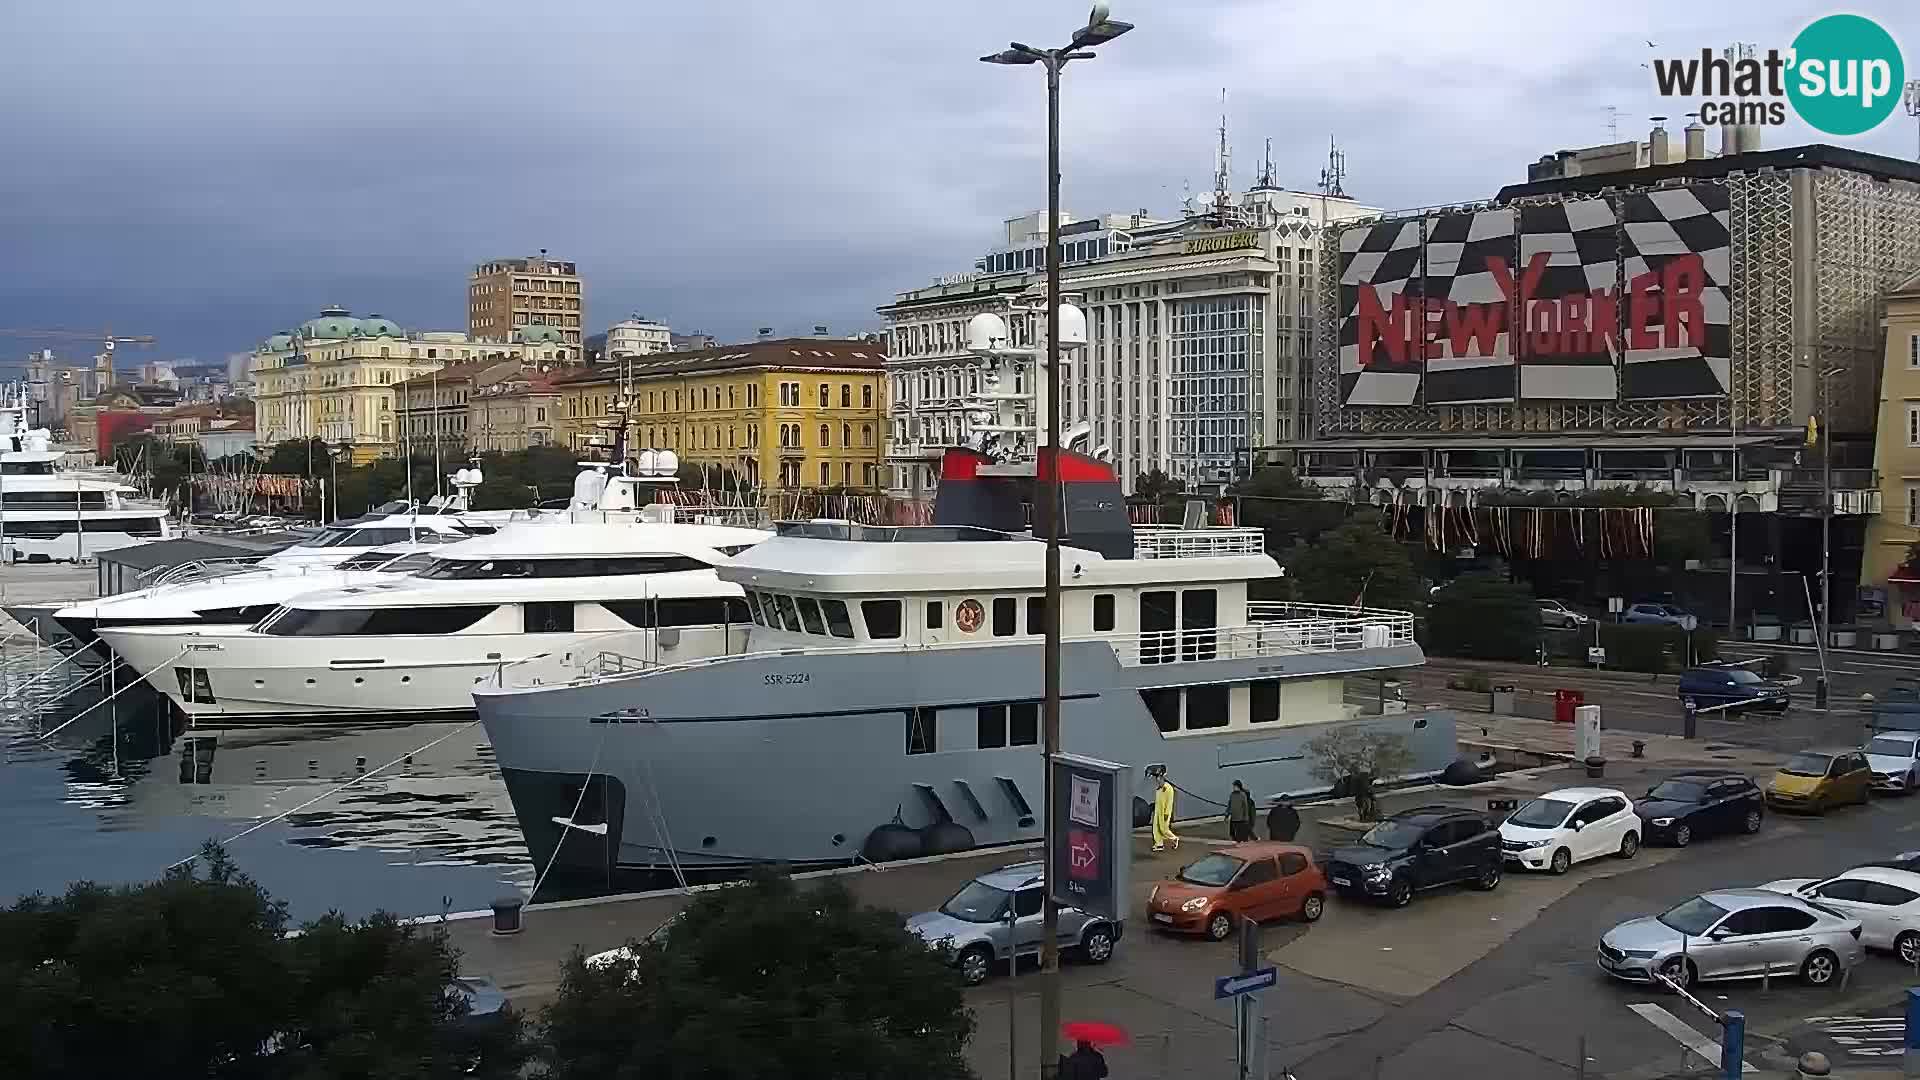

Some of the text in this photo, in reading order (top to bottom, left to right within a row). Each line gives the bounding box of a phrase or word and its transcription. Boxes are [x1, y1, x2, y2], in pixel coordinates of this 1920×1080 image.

[1358, 250, 1705, 365] NEW YORKER
[764, 673, 810, 685] SSR 5224
